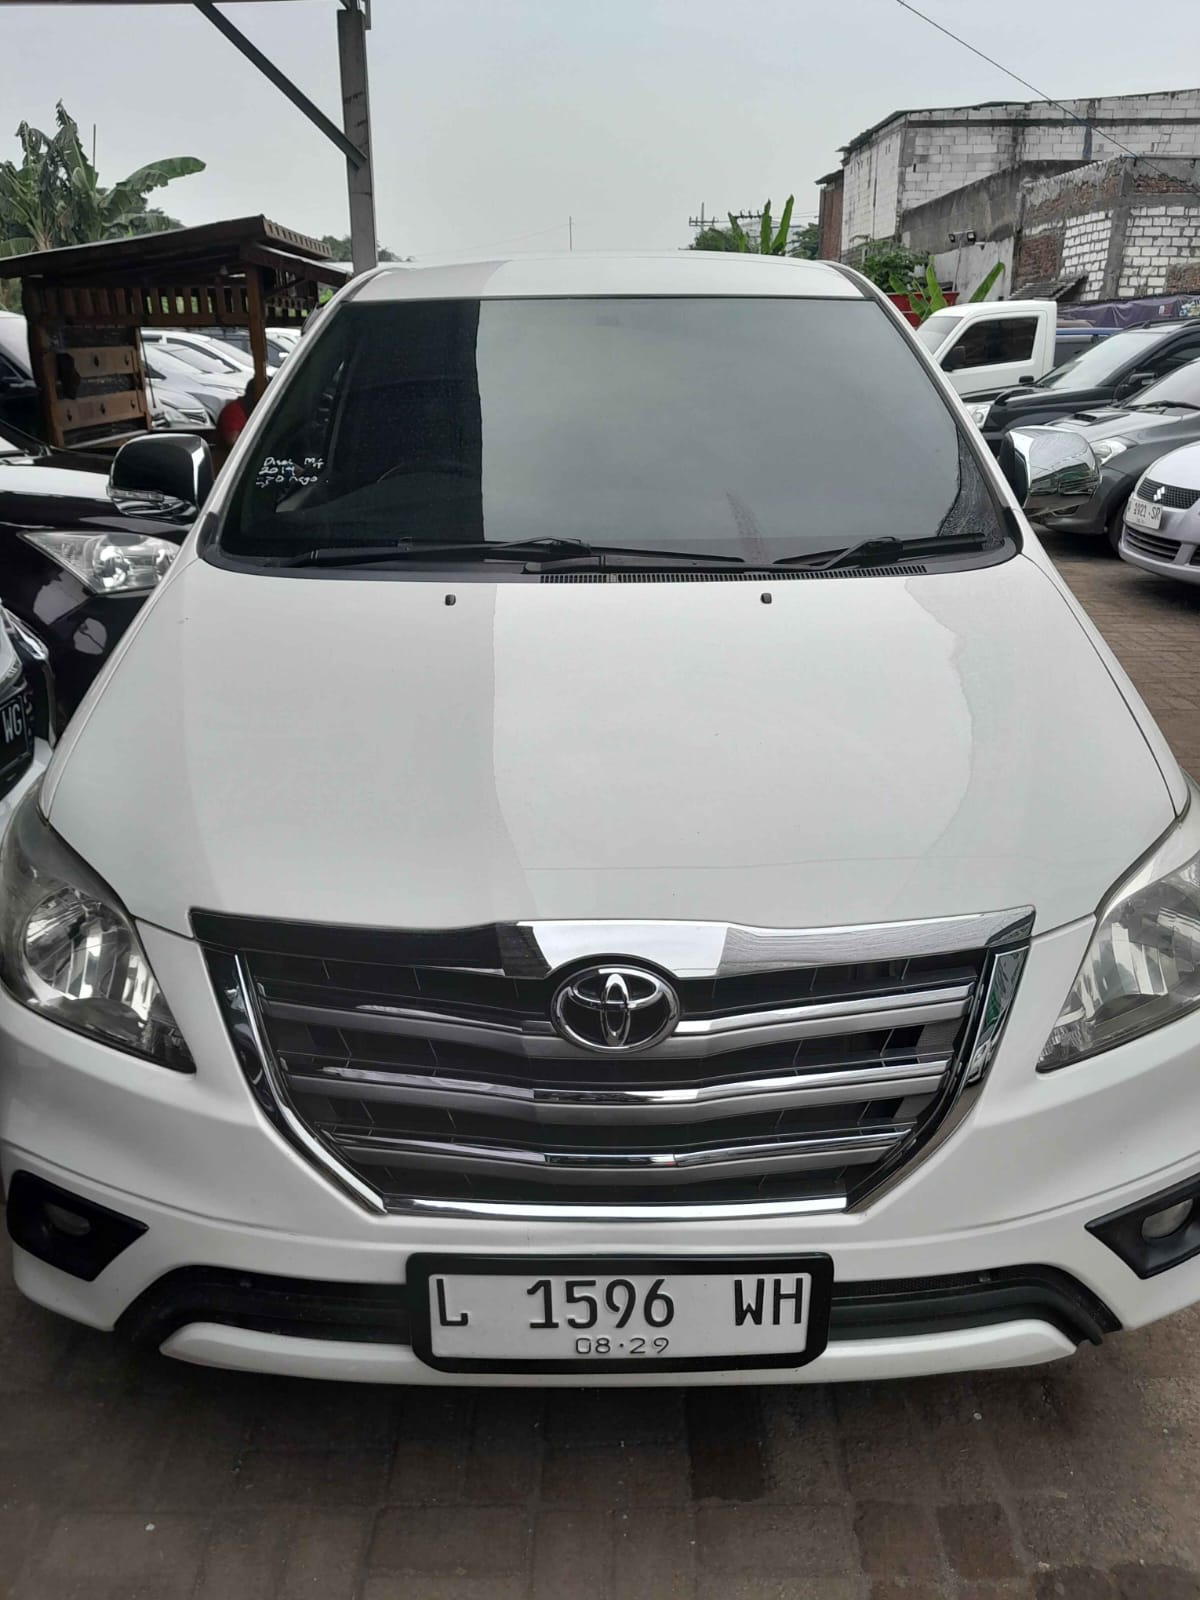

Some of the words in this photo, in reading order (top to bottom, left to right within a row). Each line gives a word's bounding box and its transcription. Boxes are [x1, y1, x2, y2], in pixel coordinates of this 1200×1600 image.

[2, 703, 22, 743] WG
[435, 1278, 468, 1326] L
[526, 1278, 675, 1329] 1596
[734, 1277, 803, 1325] WH
